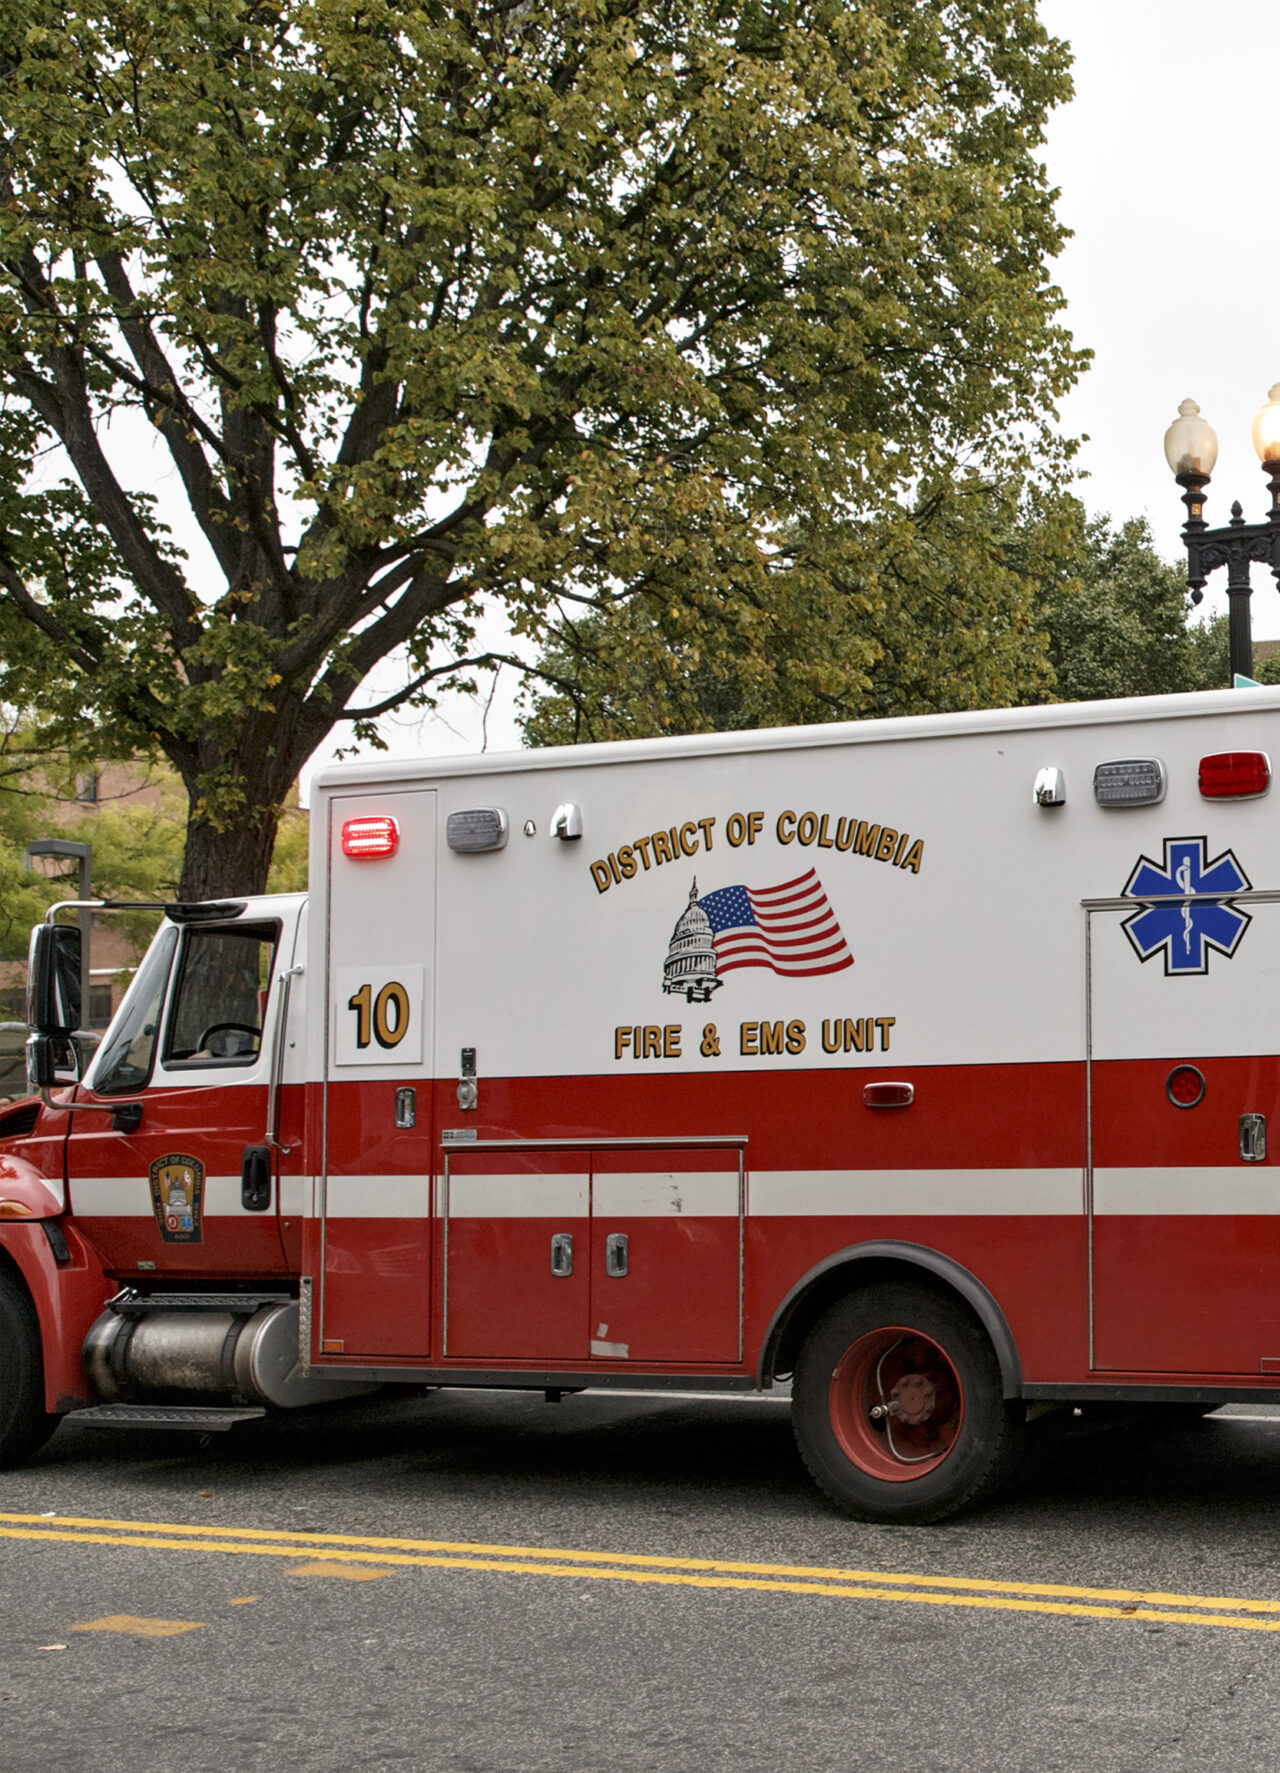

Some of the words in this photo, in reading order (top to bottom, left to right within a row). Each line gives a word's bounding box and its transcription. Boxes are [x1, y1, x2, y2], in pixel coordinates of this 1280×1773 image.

[590, 817, 716, 894] DISTRICT
[727, 811, 765, 847] OF
[776, 810, 925, 874] COLUMBIA
[348, 981, 411, 1050] 10
[614, 1024, 682, 1059] FIRE
[700, 1022, 721, 1057] &
[740, 1019, 807, 1056] EMS
[821, 1017, 896, 1053] UNIT
